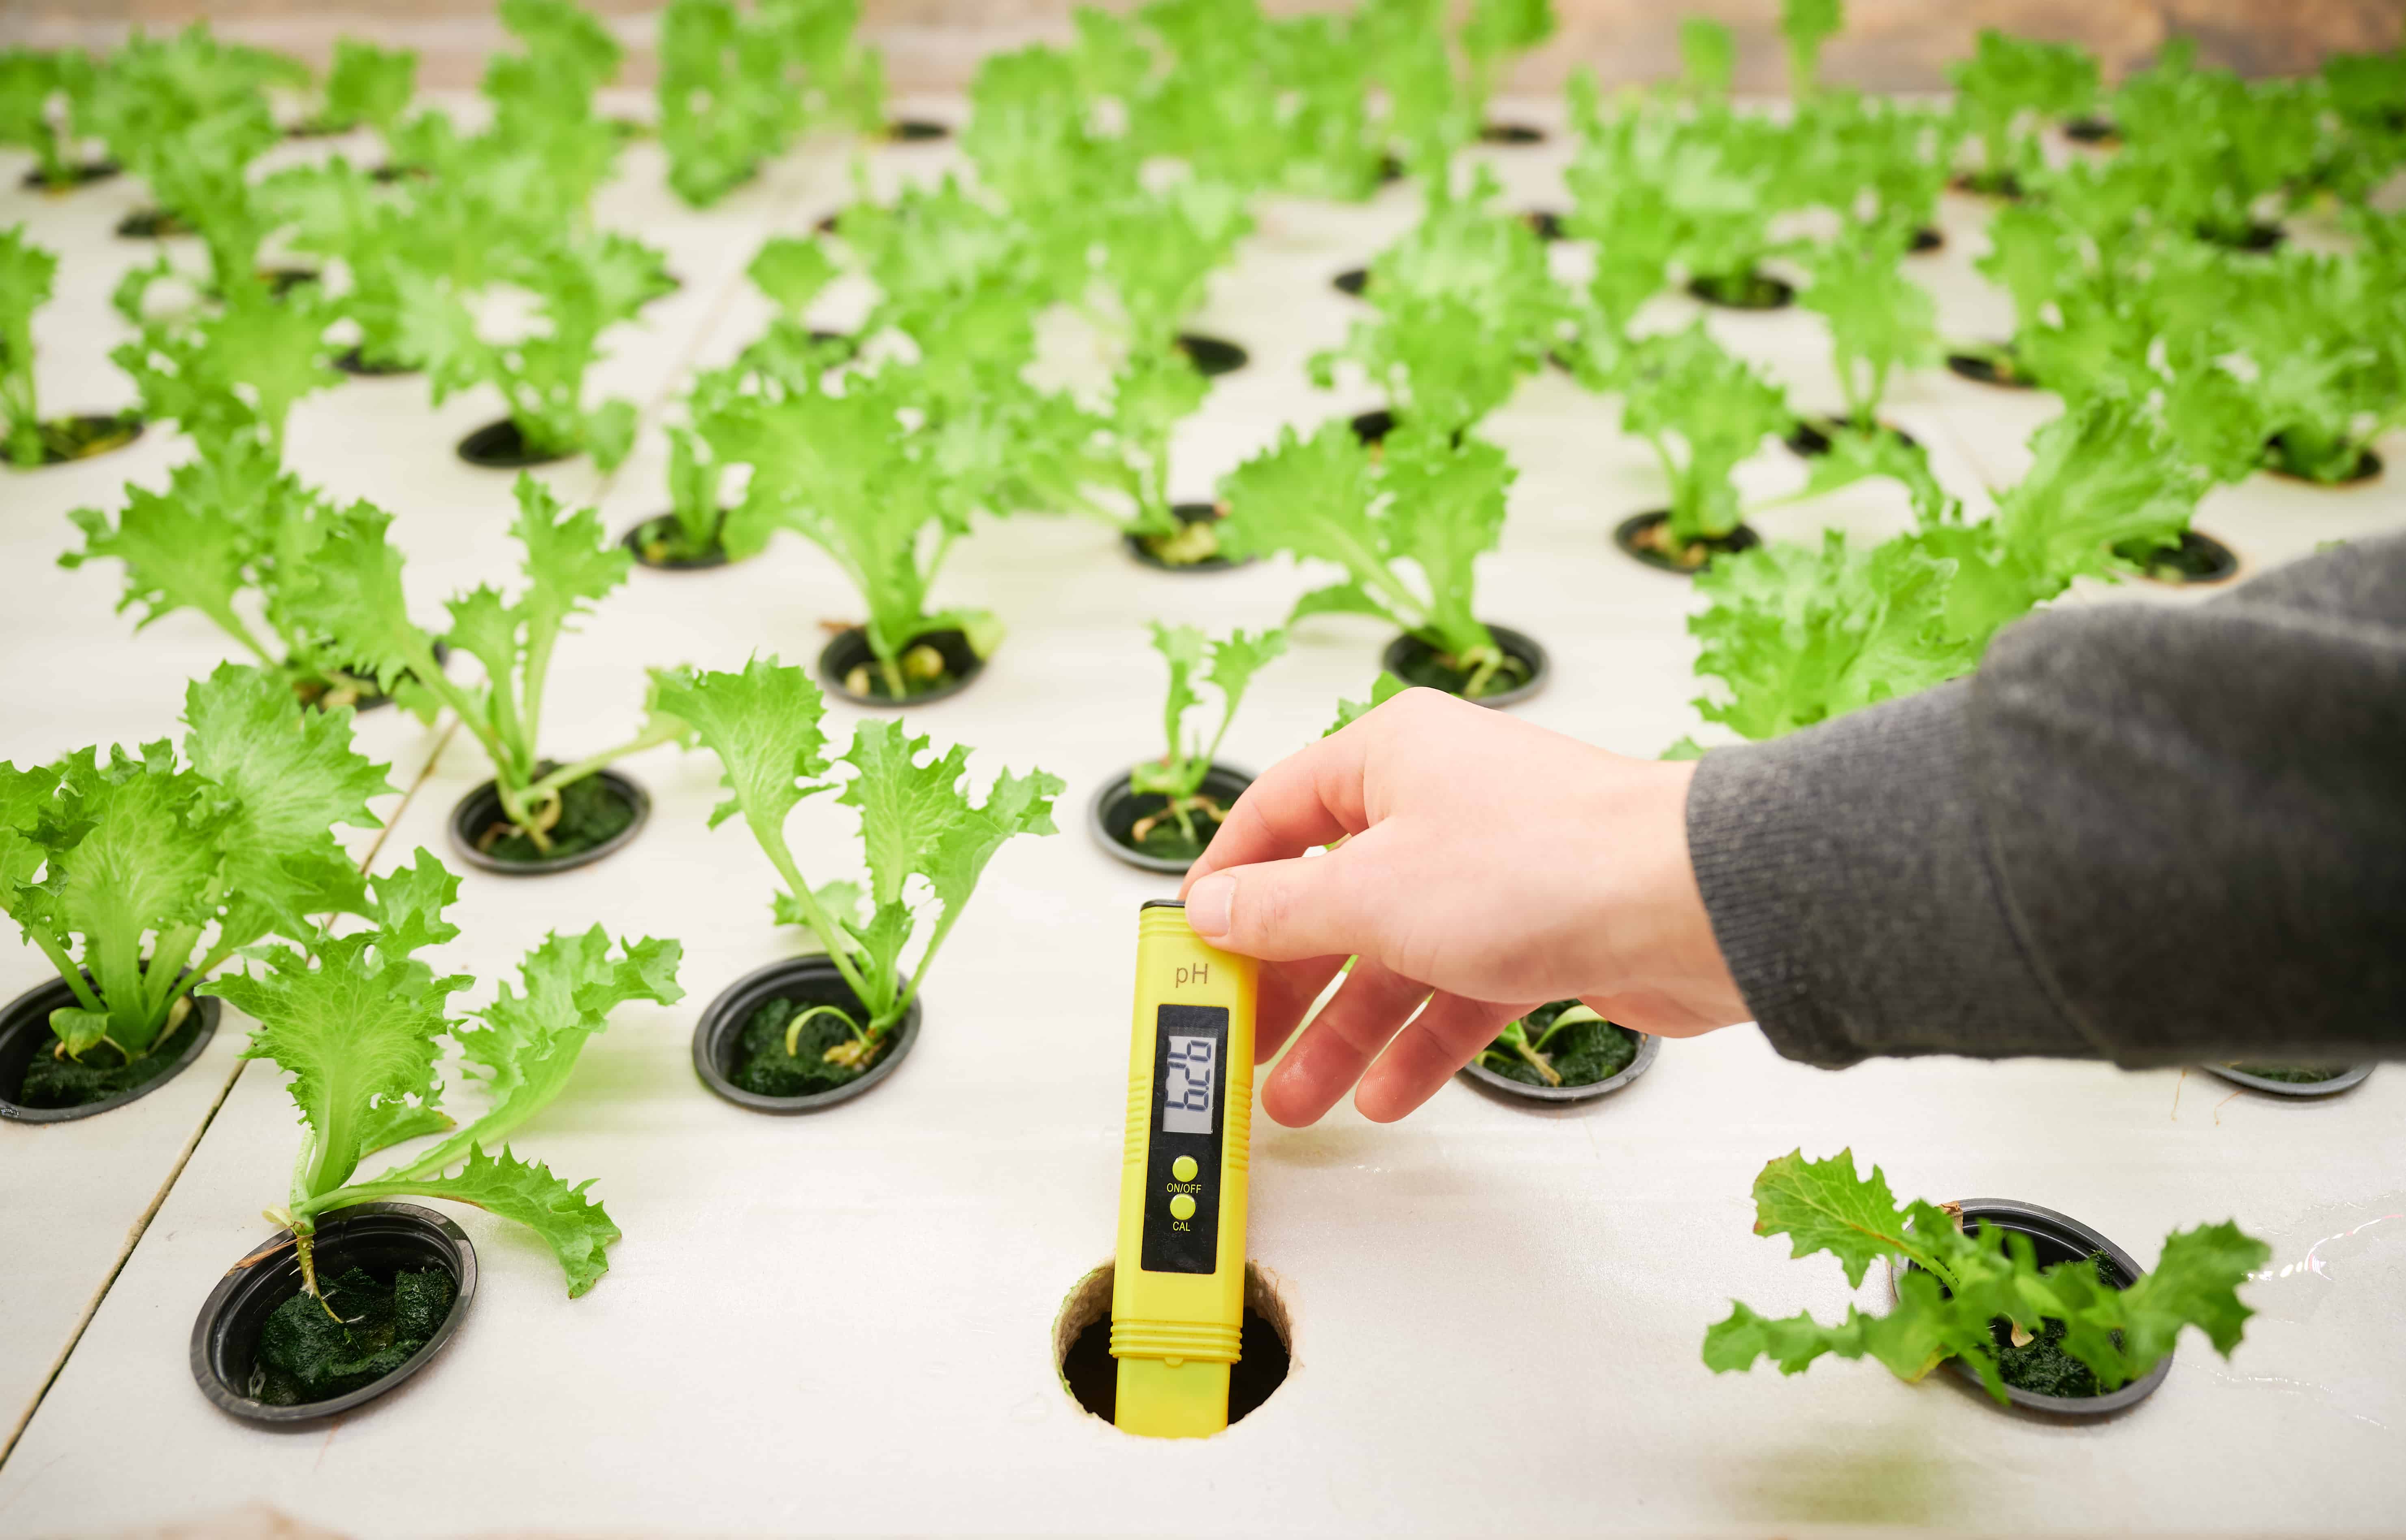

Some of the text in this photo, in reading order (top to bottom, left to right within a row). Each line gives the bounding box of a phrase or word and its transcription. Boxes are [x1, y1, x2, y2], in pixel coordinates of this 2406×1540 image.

[1176, 963, 1208, 988] pH
[1165, 1040, 1211, 1111] 6.26
[1167, 1183, 1201, 1194] ON/OFF
[1173, 1221, 1190, 1231] CAL
